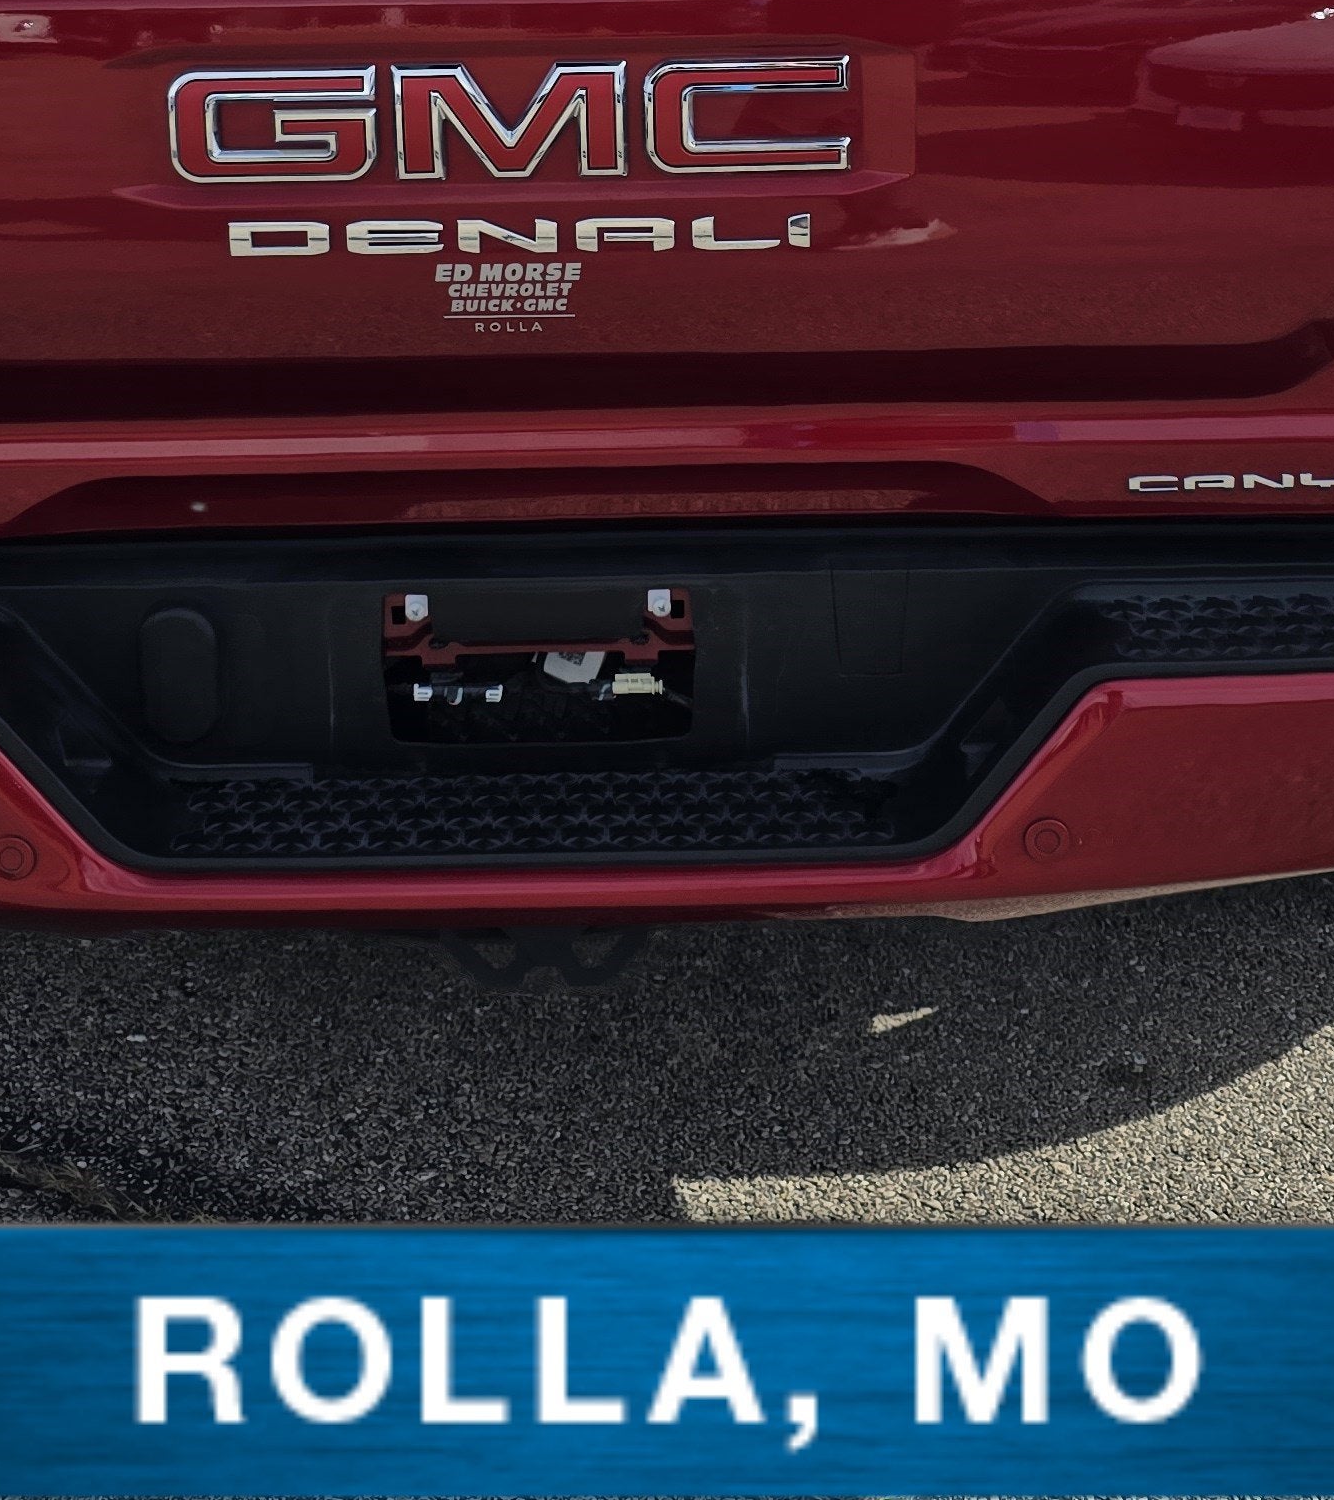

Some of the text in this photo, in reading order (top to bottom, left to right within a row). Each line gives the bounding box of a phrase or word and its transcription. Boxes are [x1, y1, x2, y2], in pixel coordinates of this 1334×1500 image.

[168, 54, 852, 183] GMC
[228, 212, 812, 257] DENALI
[435, 262, 582, 282] ED MORSE
[448, 282, 573, 297] CHEVROLET
[474, 321, 543, 332] ROLLA
